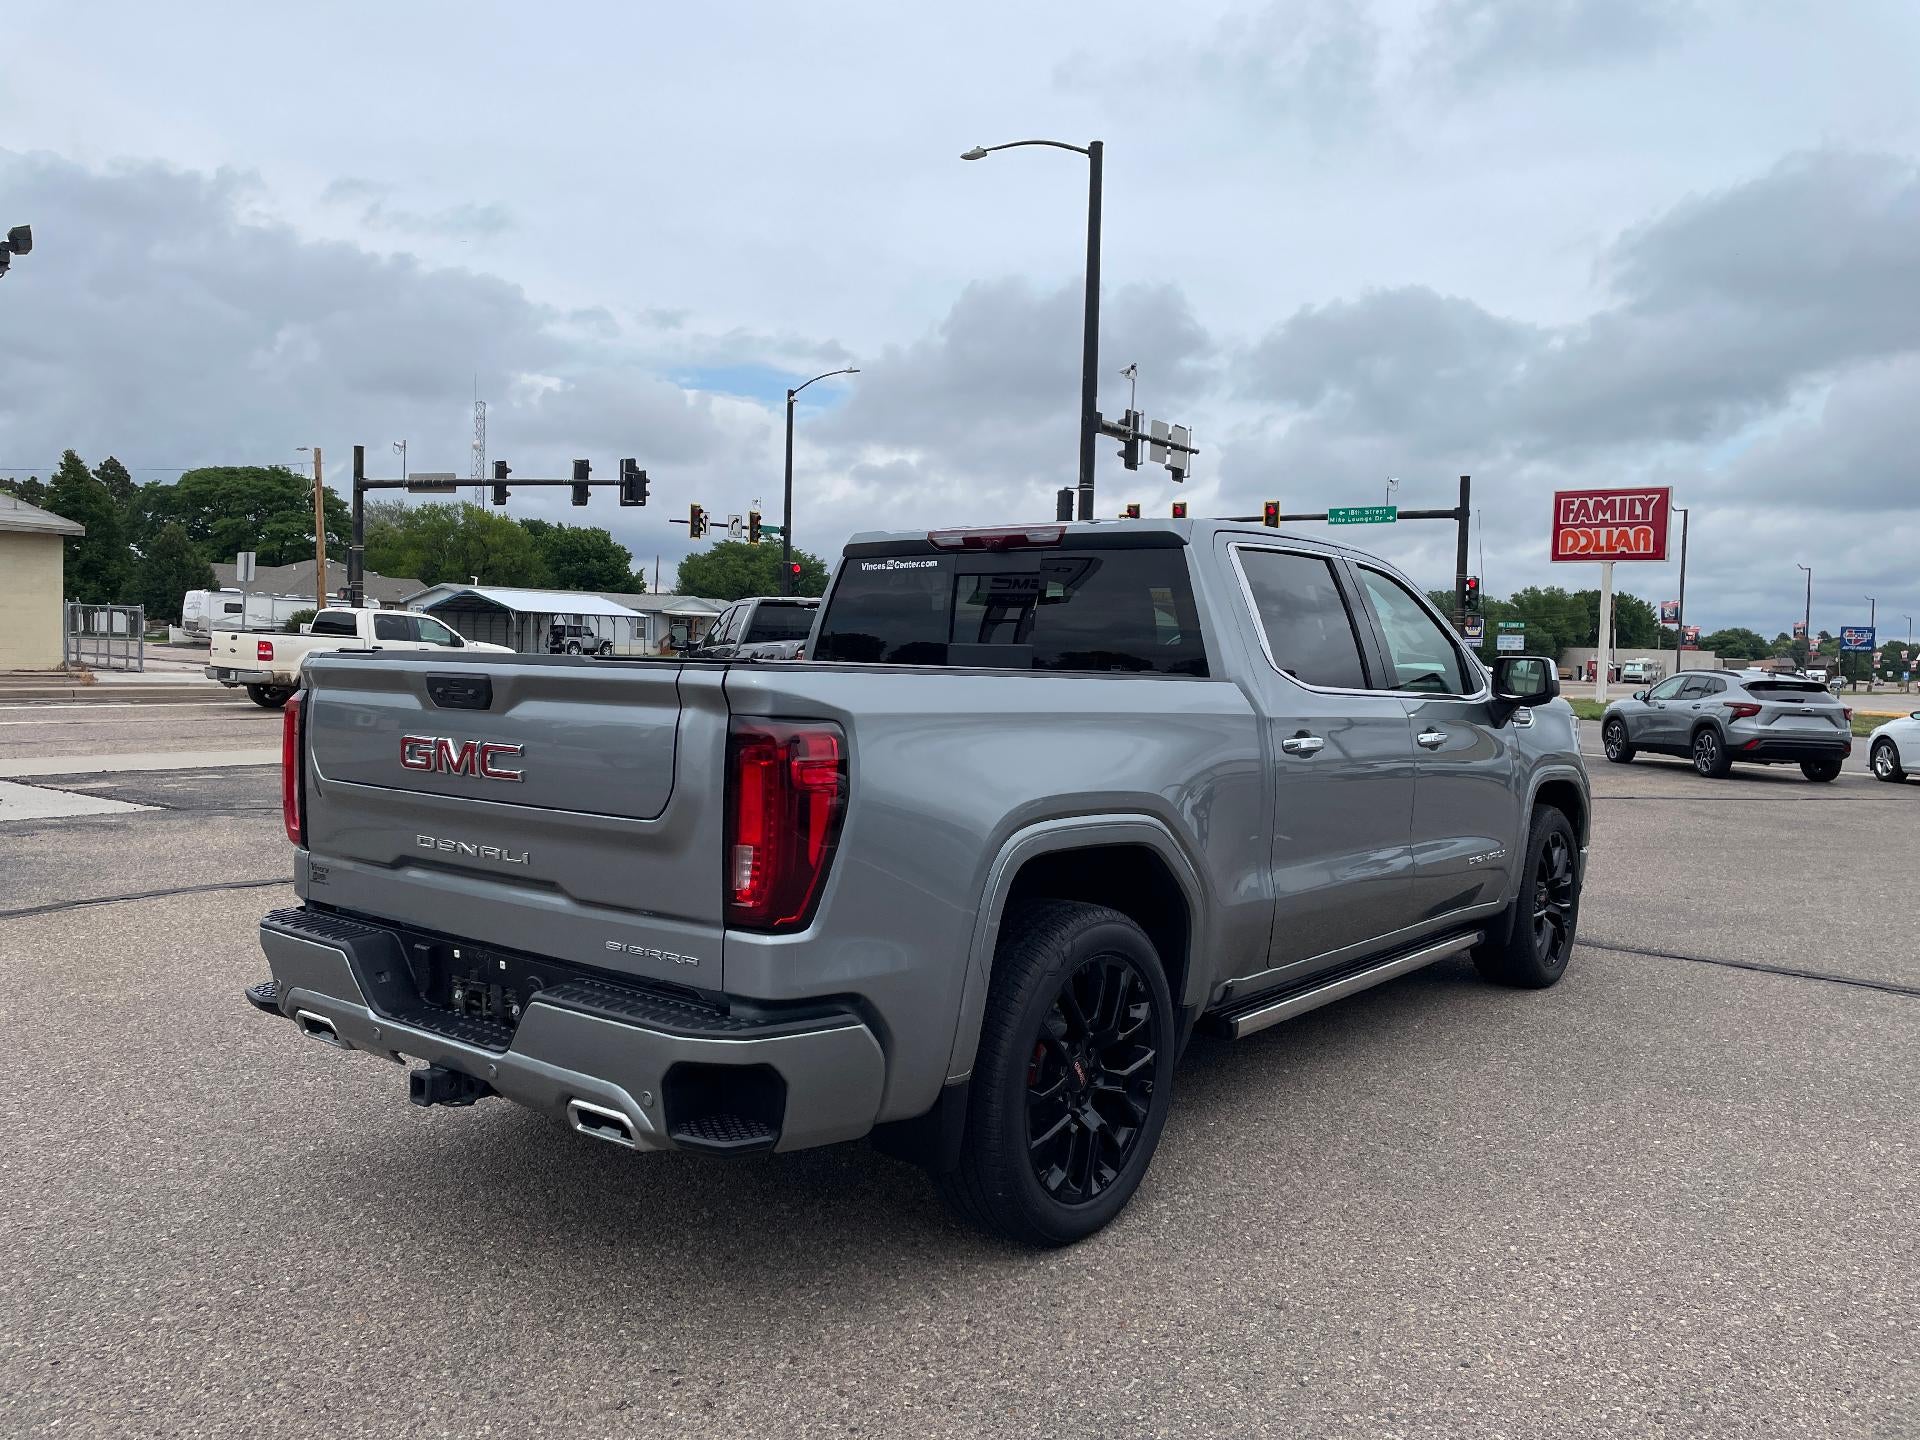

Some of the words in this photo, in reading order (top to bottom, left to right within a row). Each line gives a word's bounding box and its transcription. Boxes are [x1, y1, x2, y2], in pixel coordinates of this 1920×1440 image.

[1560, 495, 1660, 524] FAMILY
[1559, 526, 1655, 554] DOLLAR
[400, 734, 525, 783] GMC
[416, 834, 530, 865] DENALI
[605, 940, 700, 967] SIERRA
